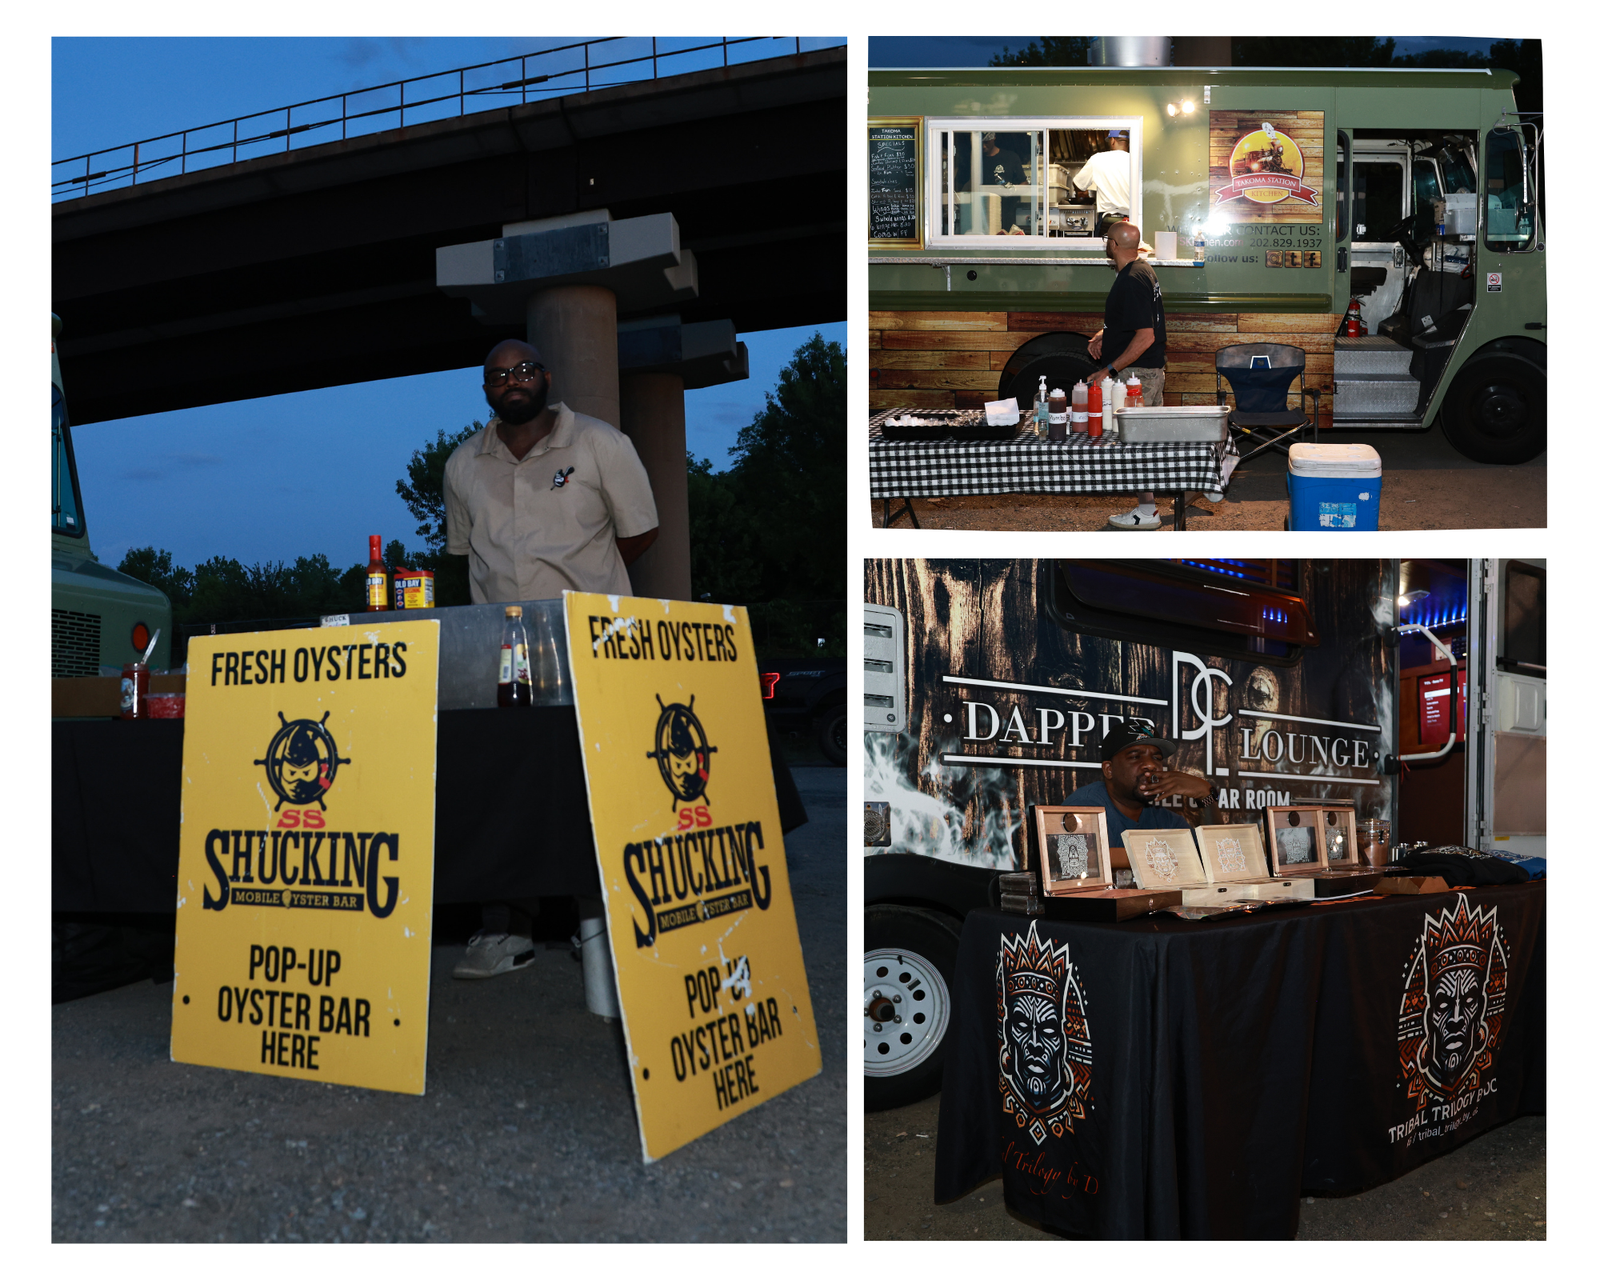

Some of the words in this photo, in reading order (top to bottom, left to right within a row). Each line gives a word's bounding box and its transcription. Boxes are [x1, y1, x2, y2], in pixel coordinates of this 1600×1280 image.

[1236, 177, 1266, 187] TAKOMA
[1267, 176, 1297, 187] STATION
[1251, 190, 1284, 198] KITCHEN
[1236, 225, 1295, 236] CONTACT
[1299, 225, 1319, 236] US:
[1250, 238, 1322, 248] 202.829.1937
[1242, 255, 1259, 263] us:
[395, 580, 406, 588] OLD
[407, 579, 420, 587] BAY
[588, 615, 655, 660] FRESH
[657, 620, 737, 662] OYSTERS
[211, 648, 286, 686] FRESH
[293, 641, 407, 683] OYSTERS
[1240, 727, 1369, 768] LOUNGE
[276, 809, 326, 829] SS
[677, 805, 713, 831] SS
[1246, 789, 1290, 810] ROOM
[202, 828, 400, 919] SHUCKING
[623, 821, 772, 949] SHUCKING
[235, 890, 281, 904] MOBILE
[333, 896, 357, 908] BAR
[661, 907, 696, 929] MOBILE
[732, 893, 749, 909] BAR
[249, 944, 341, 987] POP-UP
[218, 985, 311, 1031] OYSTER
[319, 995, 371, 1038] BAR
[261, 1030, 321, 1070] HERE
[671, 1012, 745, 1083] OYSTER
[744, 997, 783, 1051] BAR
[713, 1054, 759, 1111] HERE
[1388, 1109, 1429, 1144] TRIBAL
[1431, 1090, 1476, 1122] TRILOGY
[1013, 1150, 1062, 1196] Trilogy
